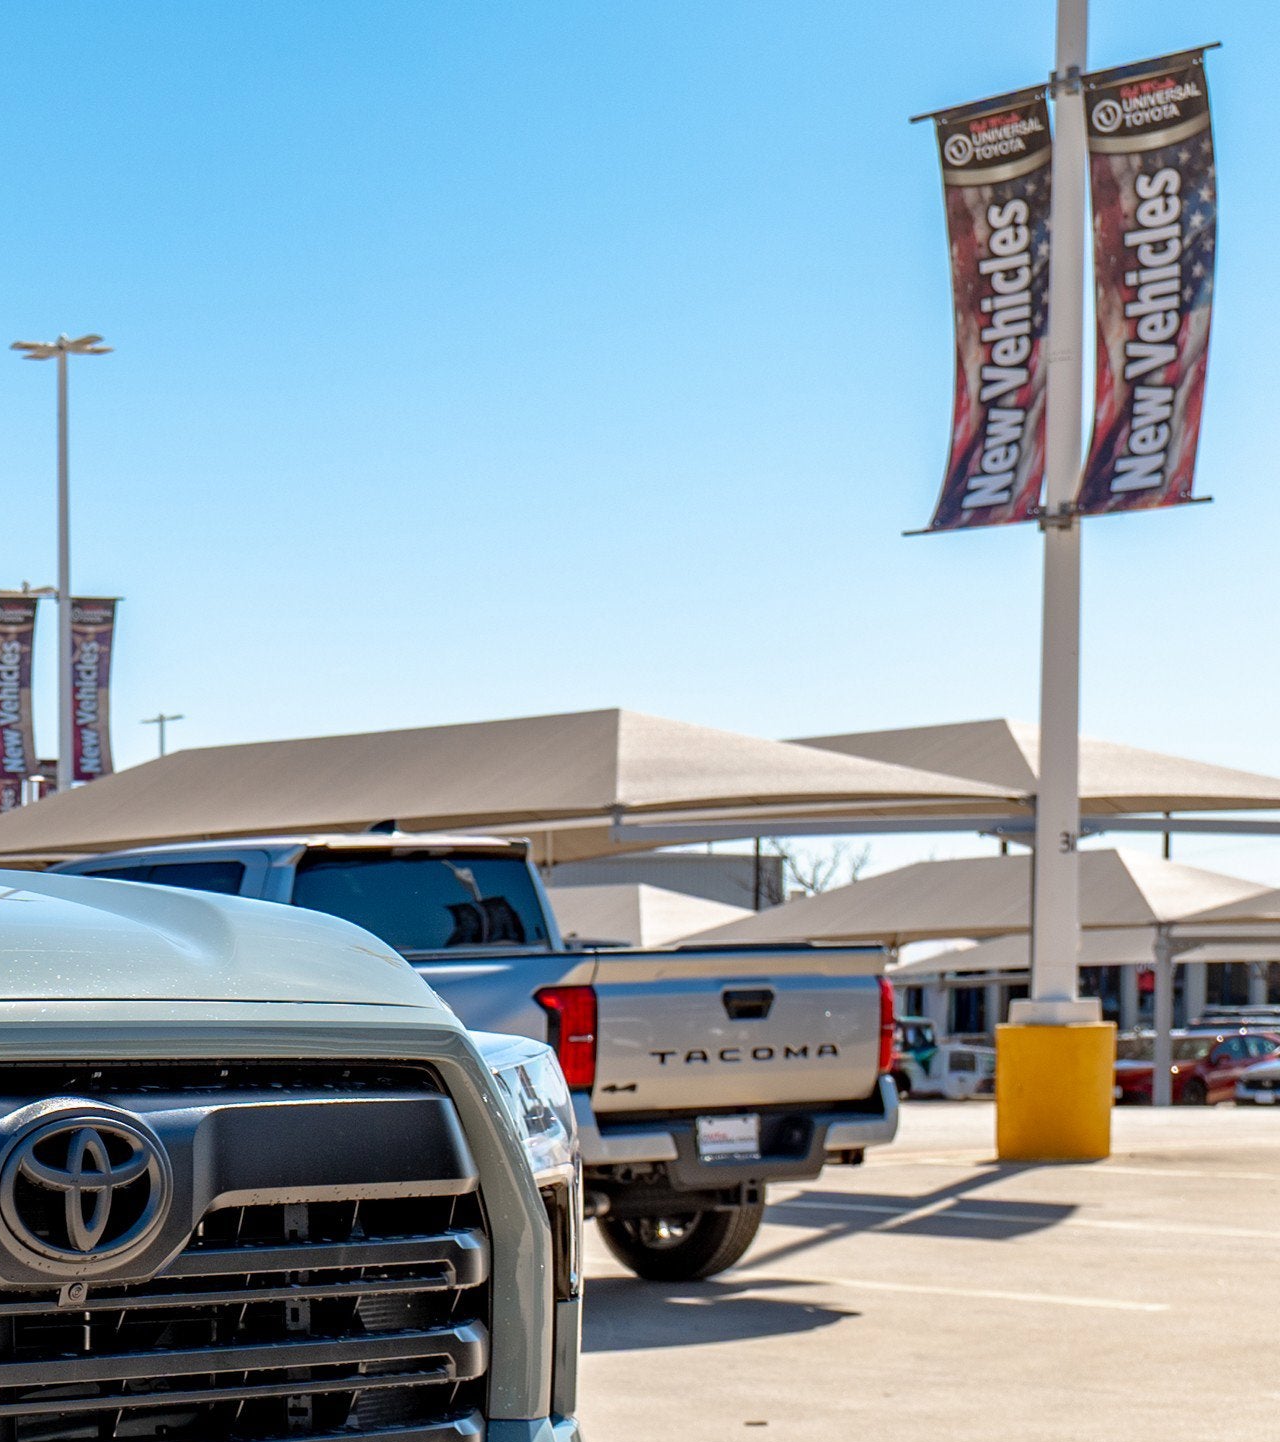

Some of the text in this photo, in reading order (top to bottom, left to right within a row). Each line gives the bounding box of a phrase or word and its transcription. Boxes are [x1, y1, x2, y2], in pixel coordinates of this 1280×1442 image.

[1121, 82, 1202, 112] UNIVERSAL
[1124, 103, 1181, 128] TOYOTA
[970, 117, 1044, 147] UNIVERSAL
[973, 137, 1026, 161] TOYOTA
[1124, 167, 1182, 380] Vehicles
[978, 198, 1032, 402] Vehicles
[962, 408, 1026, 509] New
[1110, 386, 1174, 494] New
[2, 728, 27, 773] New
[80, 728, 102, 773] New
[649, 1043, 840, 1066] TACOMA
